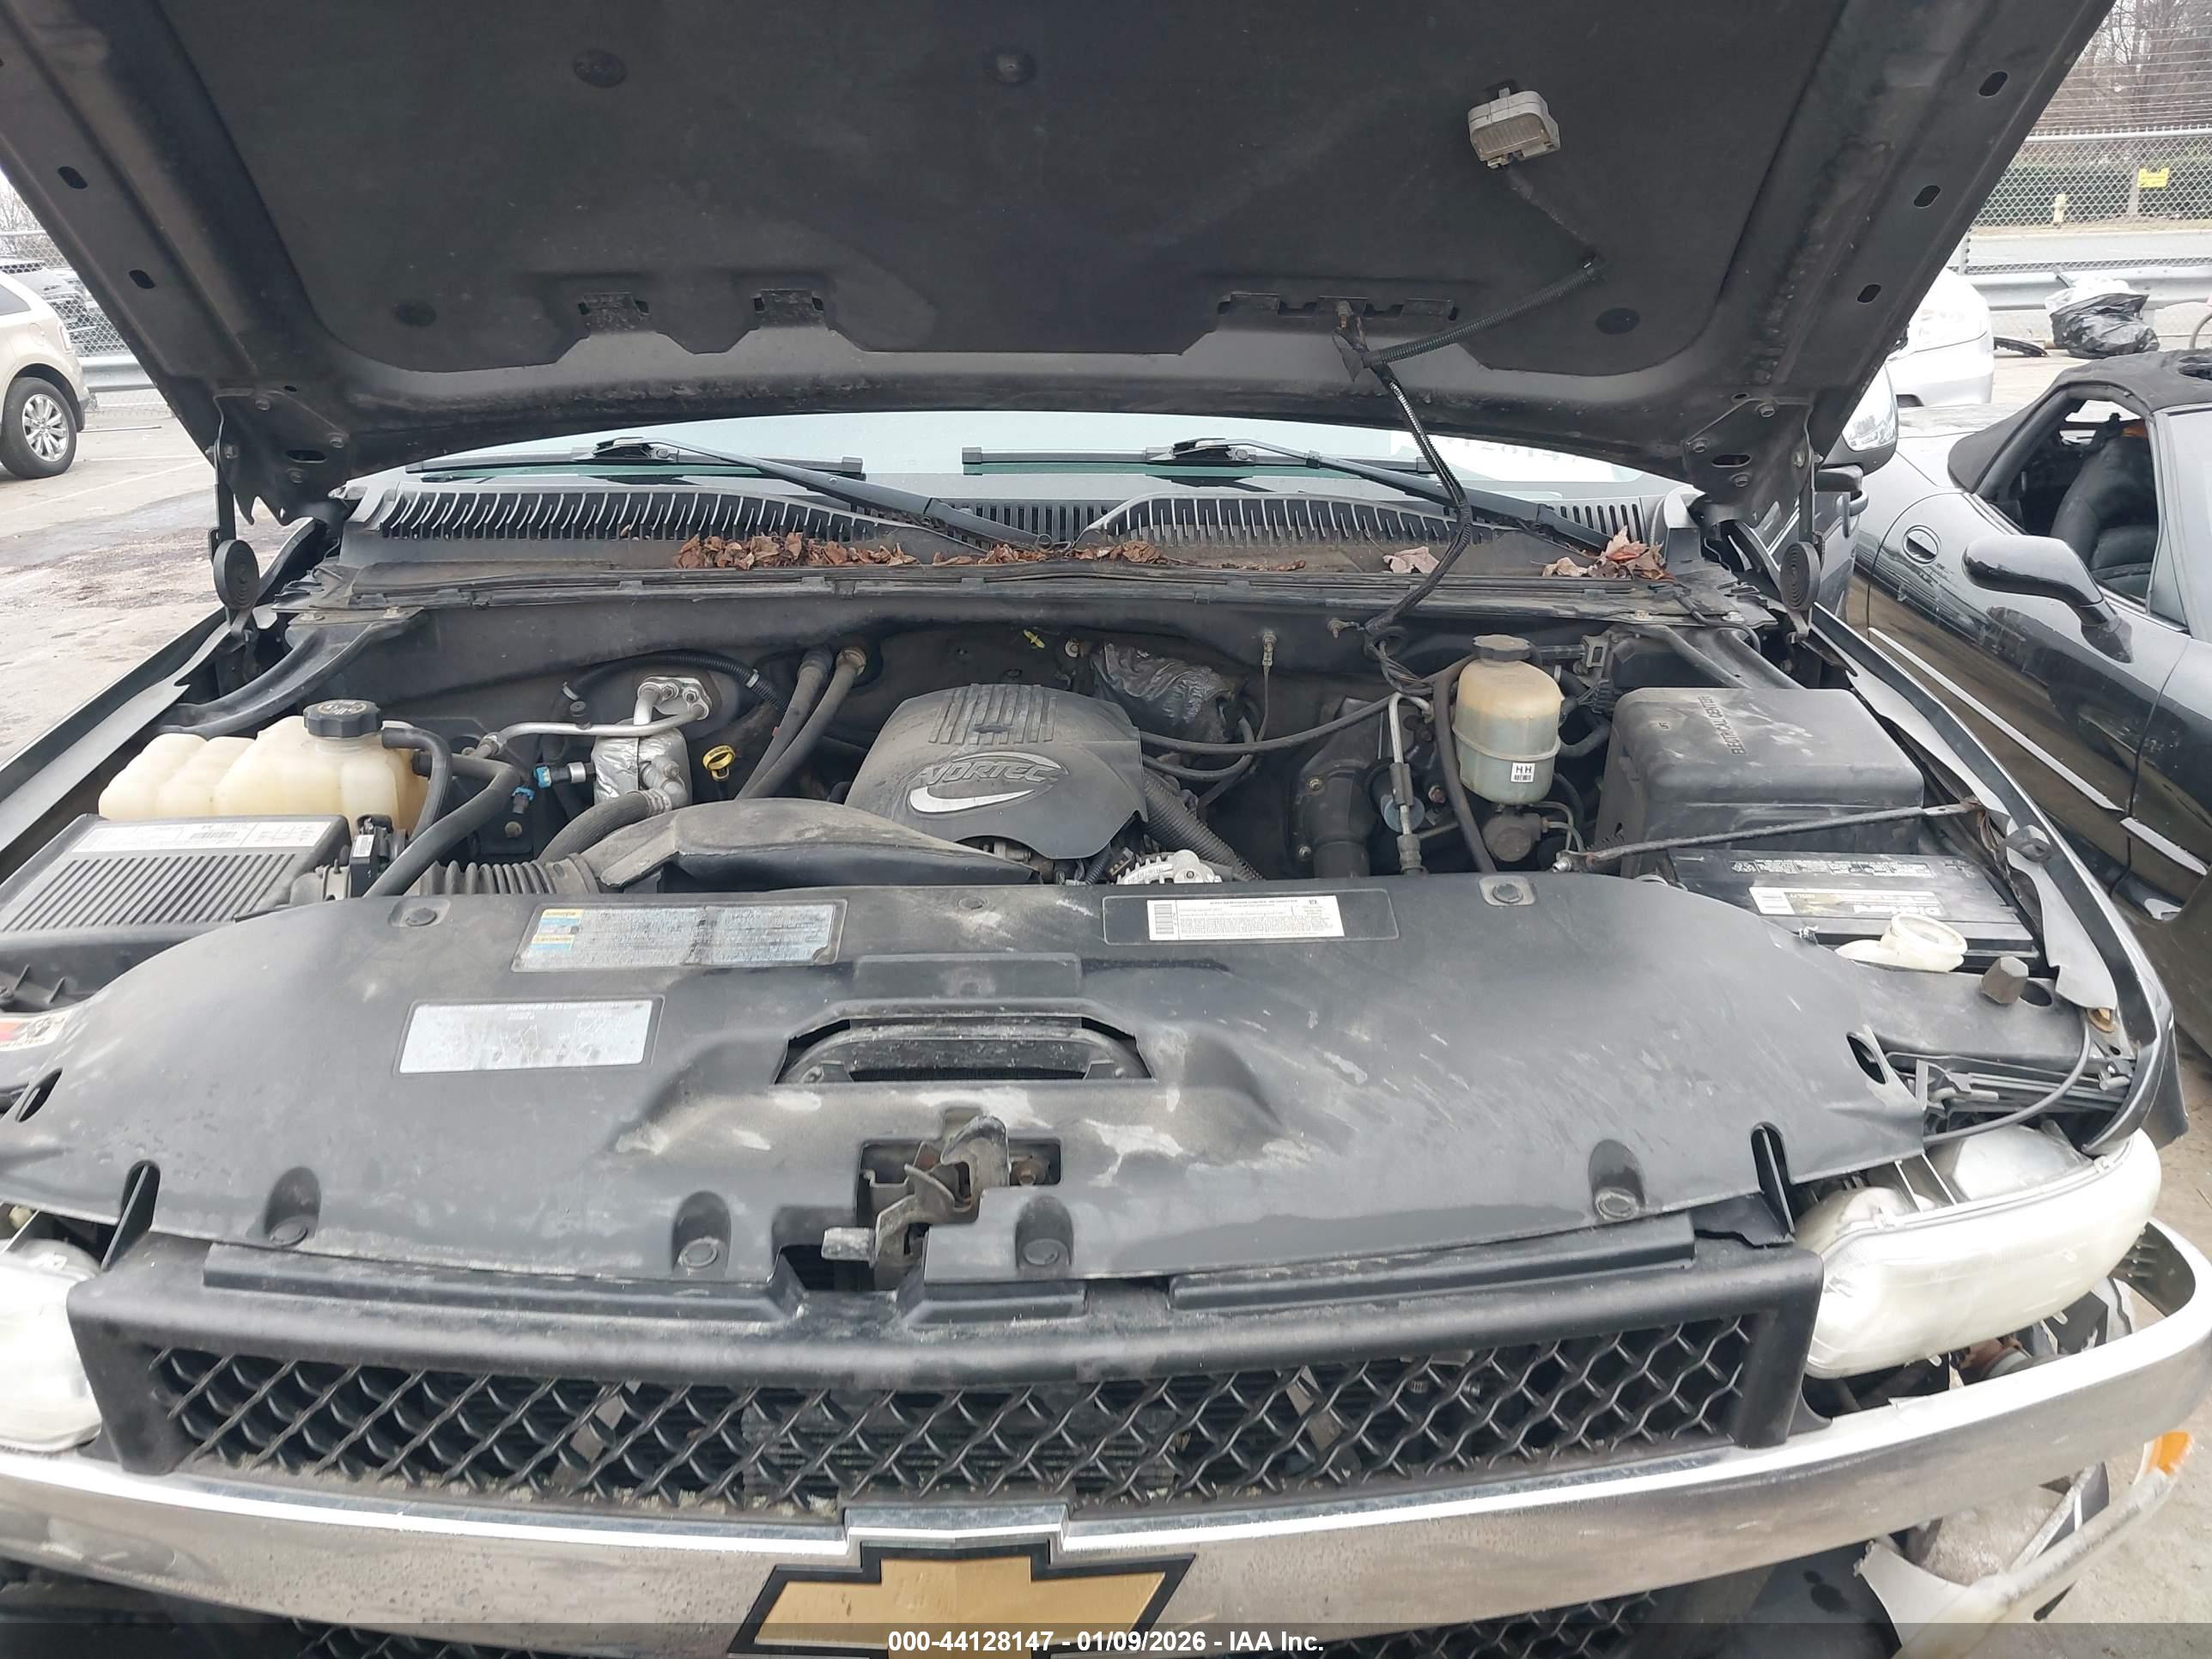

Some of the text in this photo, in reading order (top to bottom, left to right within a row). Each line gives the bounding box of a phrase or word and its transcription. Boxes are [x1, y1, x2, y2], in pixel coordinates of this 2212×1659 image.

[1698, 695, 1747, 755] ELECTRICAL CENTER
[911, 760, 1059, 786] VORTEC
